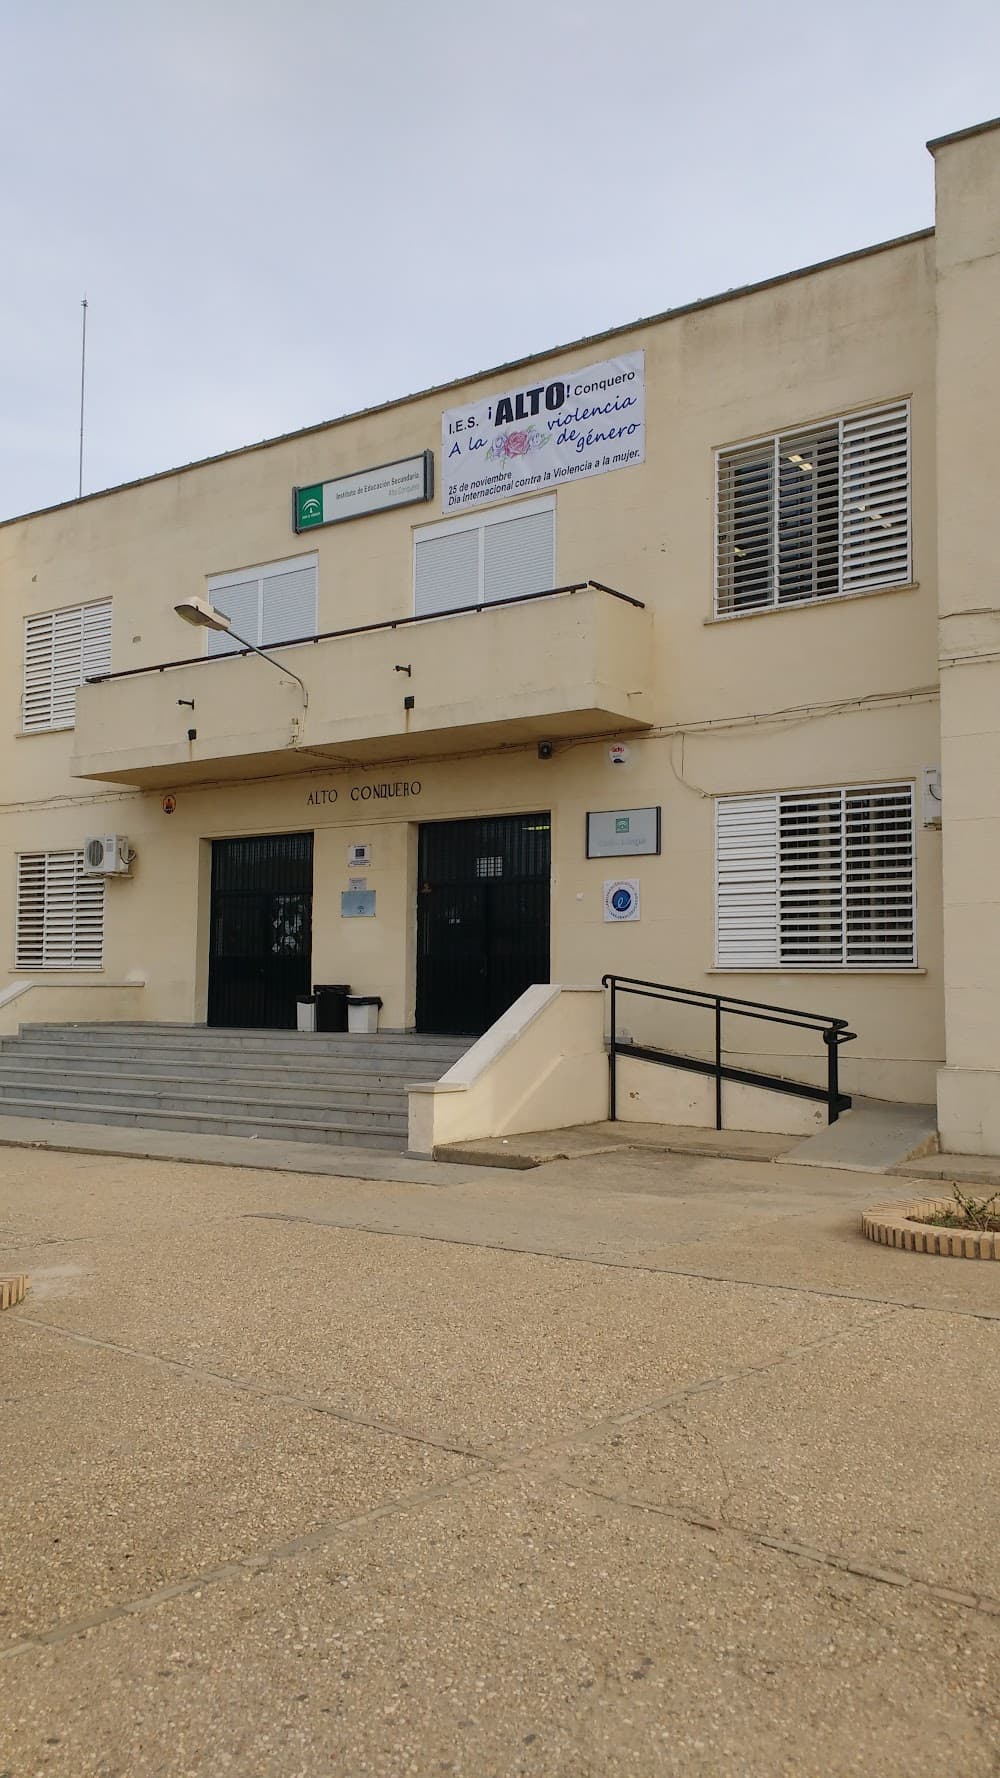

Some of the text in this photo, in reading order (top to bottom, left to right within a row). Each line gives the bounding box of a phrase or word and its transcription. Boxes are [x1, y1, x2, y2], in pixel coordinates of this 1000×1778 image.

[449, 371, 635, 434] I.E.S. ¡ALTO! Conquero
[449, 395, 637, 457] A la violencia
[557, 423, 640, 453] de género
[358, 486, 363, 494] de
[364, 481, 390, 492] Educación
[392, 472, 419, 485] Secundaria
[449, 471, 512, 494] 25 de noviembre
[463, 481, 513, 502] Internacional
[515, 475, 541, 488] contra
[543, 472, 551, 480] la
[554, 462, 592, 478] Violencia
[603, 456, 610, 465] la
[613, 450, 640, 465] mujer.
[307, 781, 422, 805] ALTO CONQUERO
